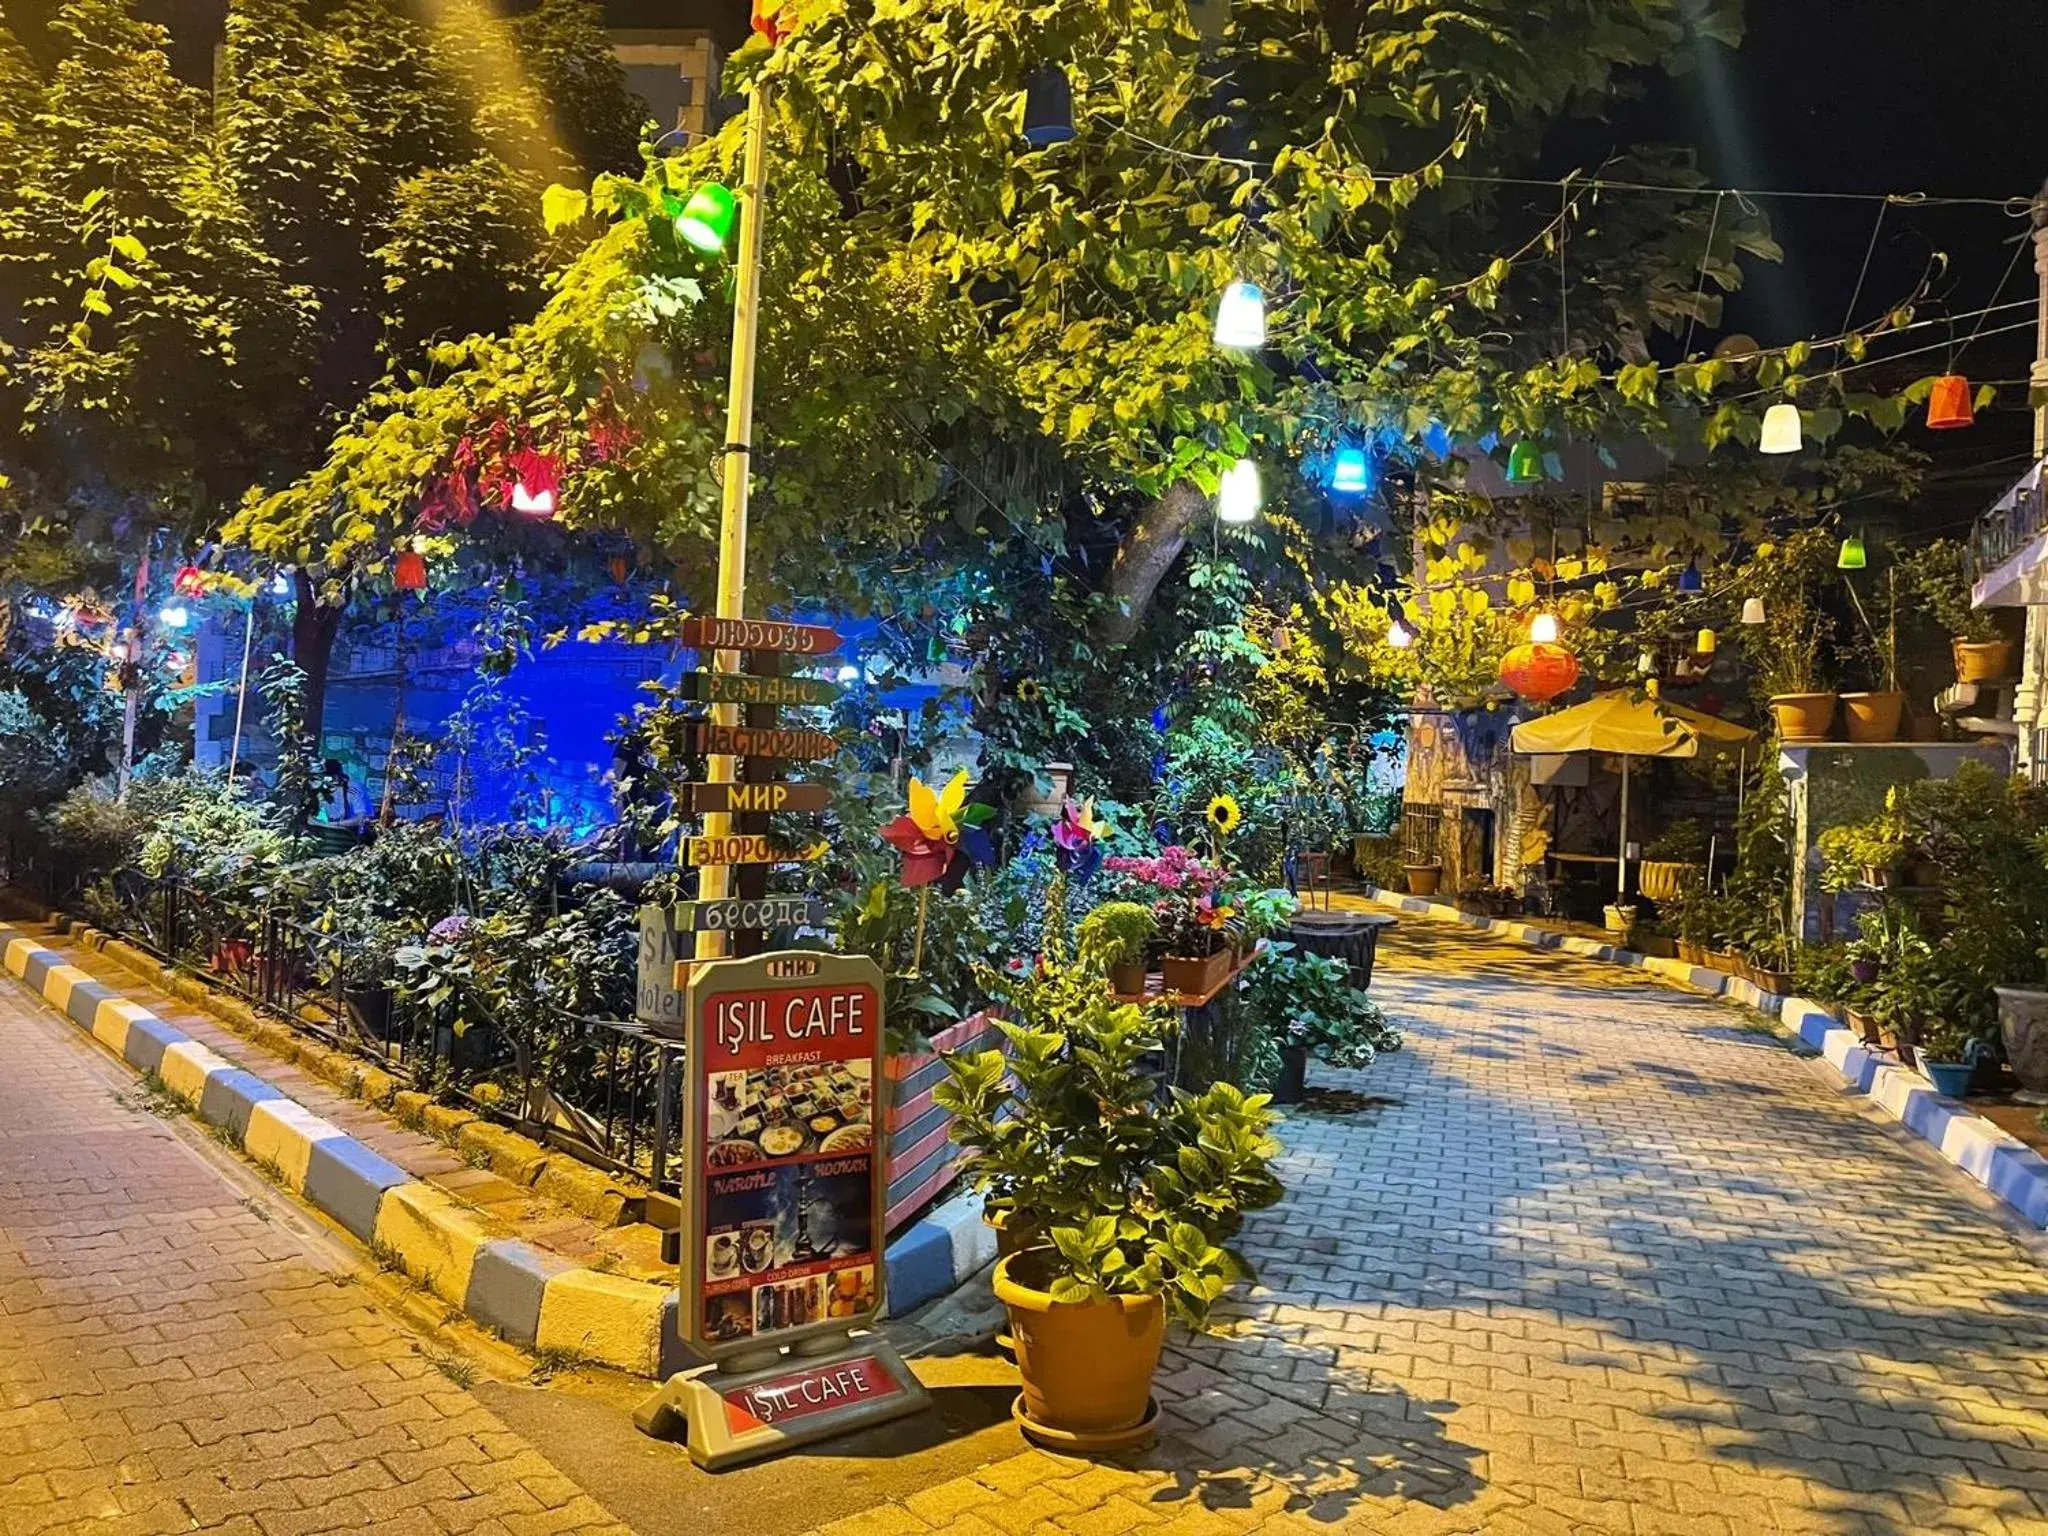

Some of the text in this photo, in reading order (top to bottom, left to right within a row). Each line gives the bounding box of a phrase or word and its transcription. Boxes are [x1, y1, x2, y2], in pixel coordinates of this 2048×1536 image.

[727, 785, 788, 810] МИР
[706, 901, 811, 929] беседа
[717, 993, 864, 1054] IŞIL CAFE
[765, 1050, 823, 1066] BREAKFAST
[744, 1368, 870, 1422] IŞIL CAFE
